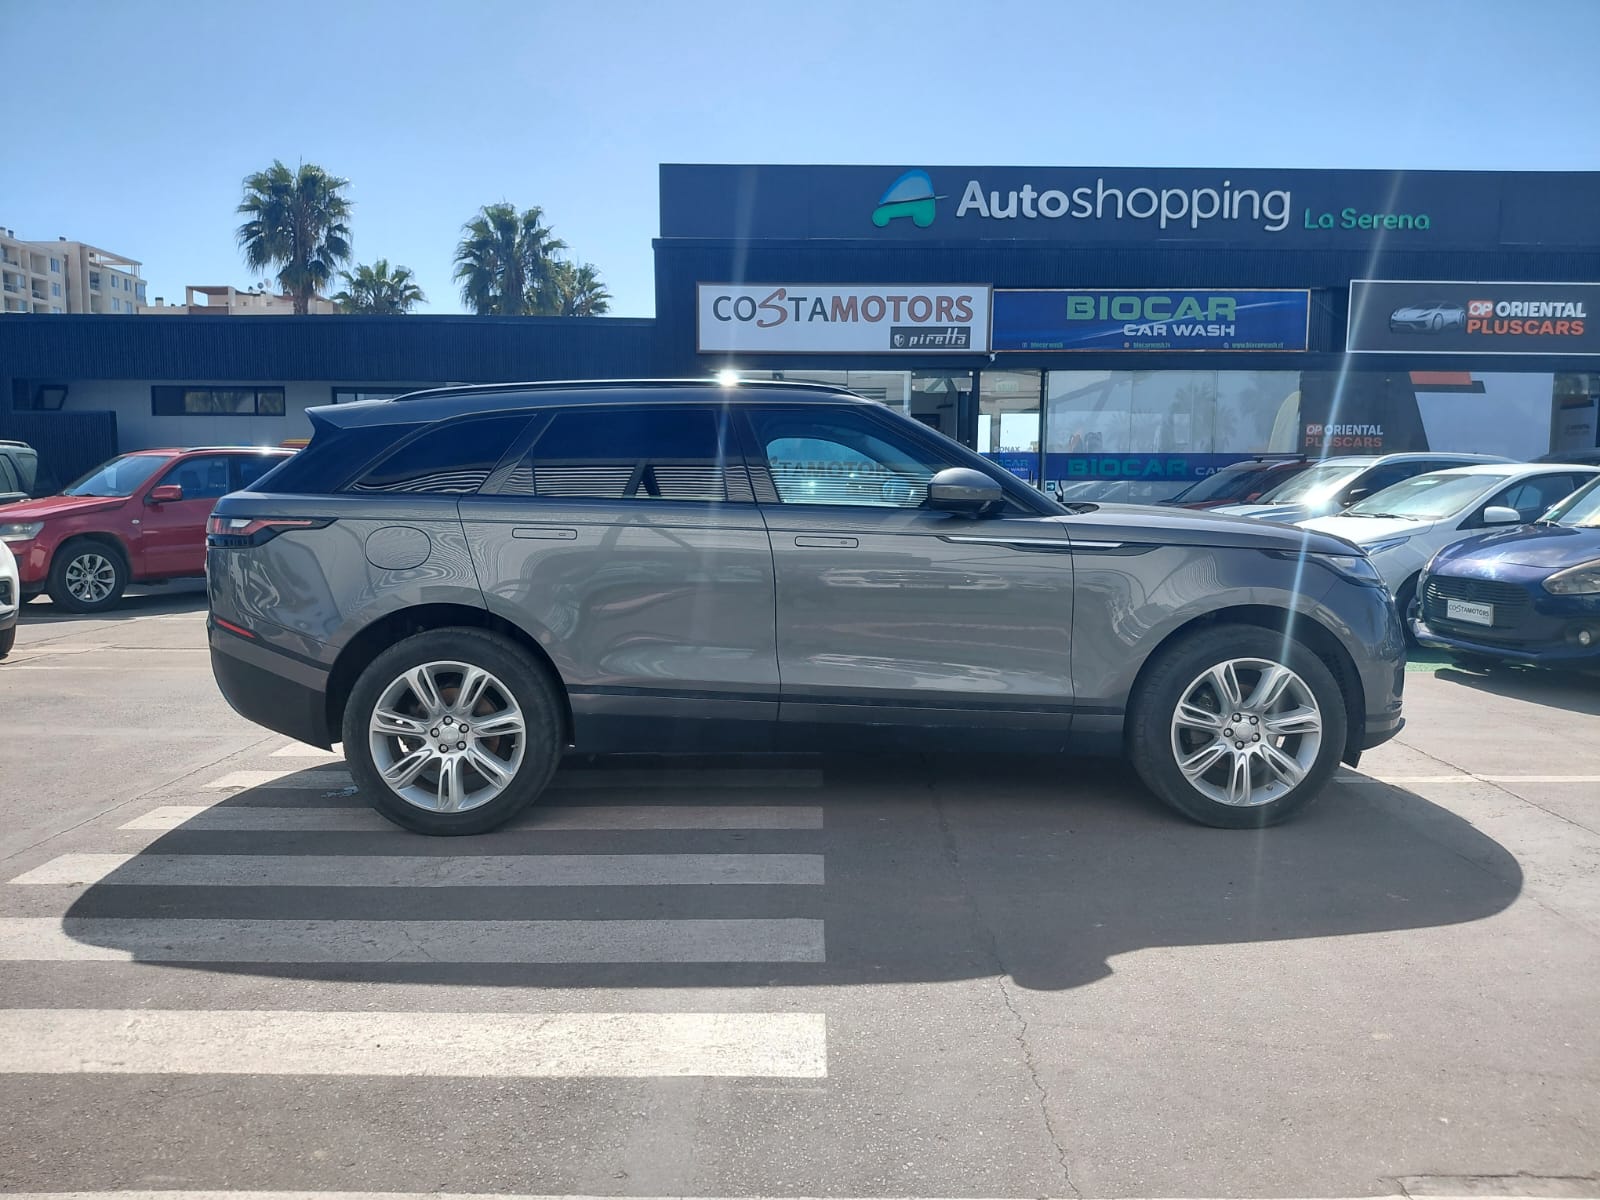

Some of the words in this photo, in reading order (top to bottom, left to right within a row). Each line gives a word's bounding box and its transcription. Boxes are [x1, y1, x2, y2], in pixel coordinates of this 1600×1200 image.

[956, 178, 1291, 232] Autoshopping
[1304, 208, 1334, 229] La
[1341, 208, 1431, 231] Serena
[713, 288, 973, 327] COSTAMOTORS
[1066, 295, 1236, 321] BIOCAR
[1468, 301, 1493, 316] OP
[1495, 301, 1586, 318] ORIENTAL
[1123, 324, 1167, 336] CAR
[1172, 324, 1235, 336] WASH
[1467, 319, 1585, 336] PLUSCARS
[1324, 424, 1384, 435] ORIENTAL
[1448, 604, 1490, 617] COSTAMOTORS
